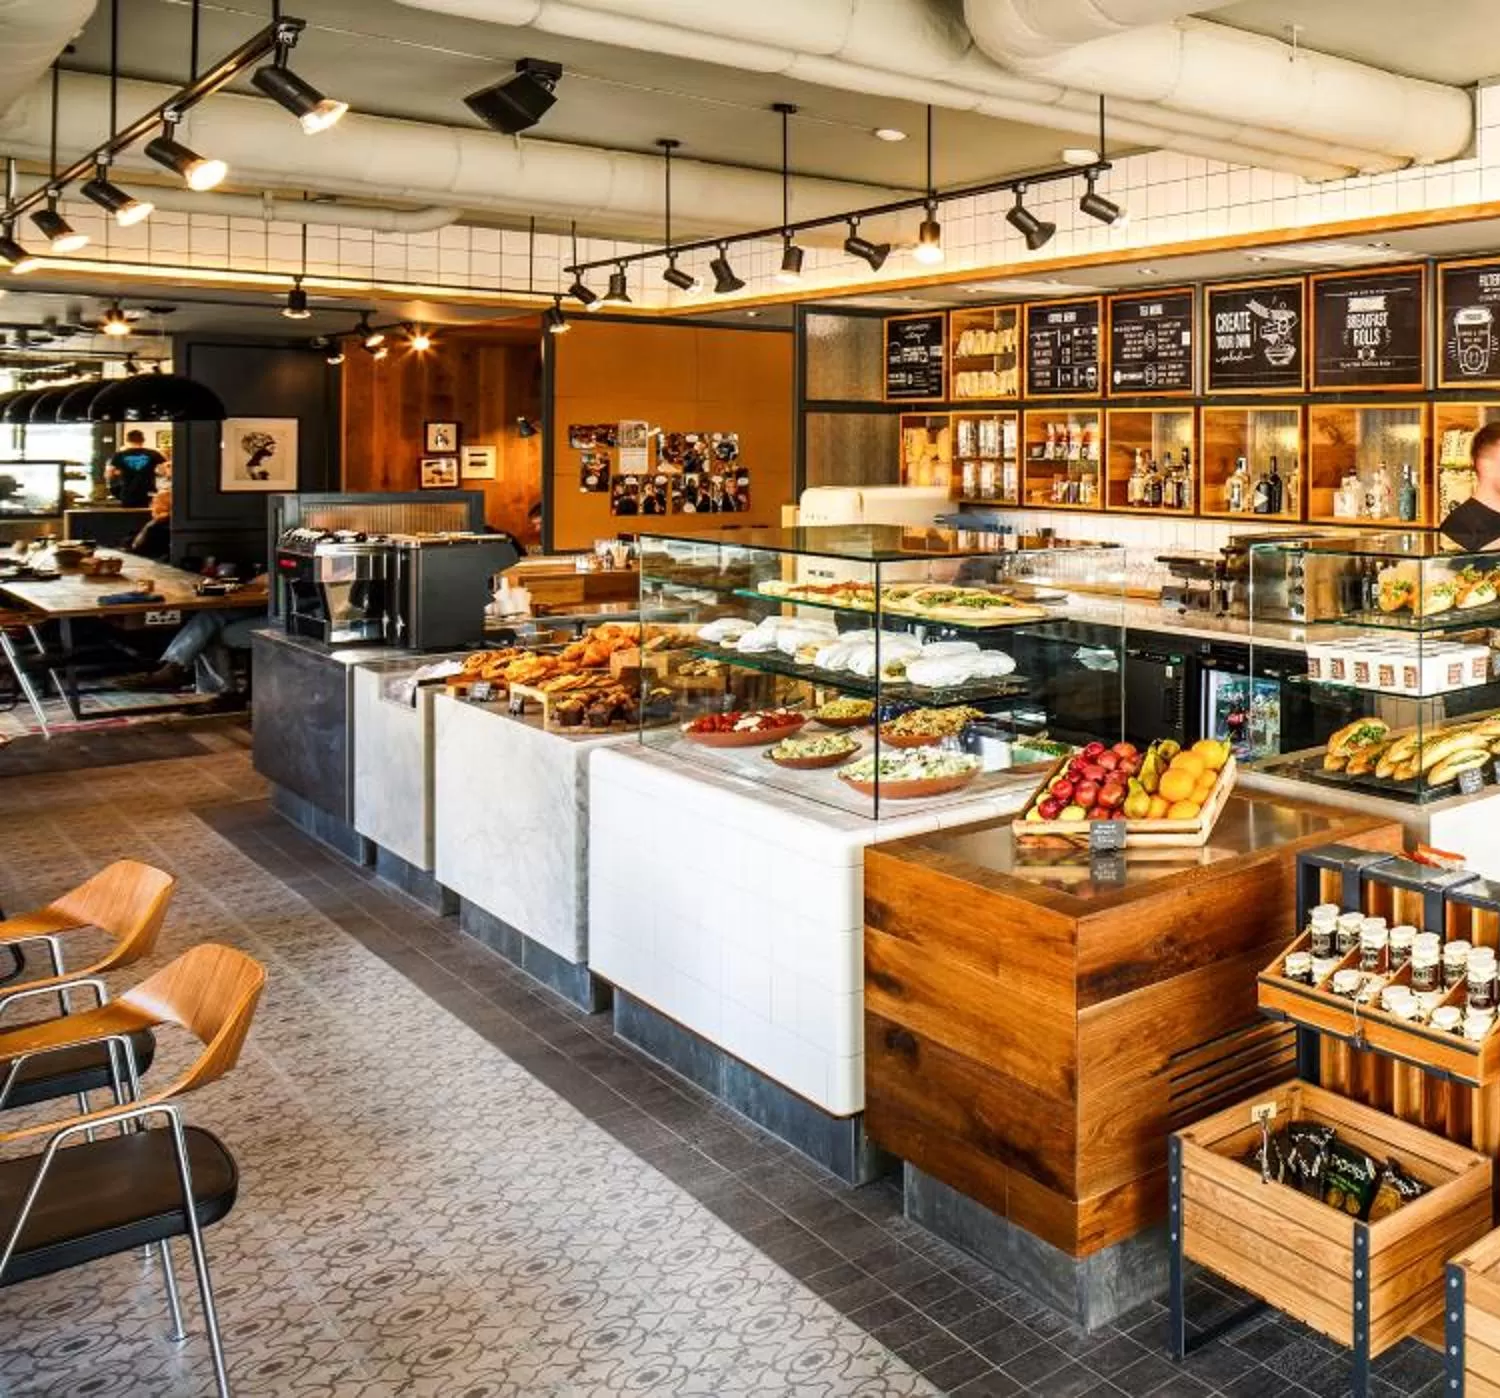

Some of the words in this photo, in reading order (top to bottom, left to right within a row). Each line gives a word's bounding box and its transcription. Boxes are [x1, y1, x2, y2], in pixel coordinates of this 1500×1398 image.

[1215, 311, 1251, 333] CREATE
[1346, 311, 1389, 329] BREAKFAST
[1352, 328, 1381, 347] ROLLS
